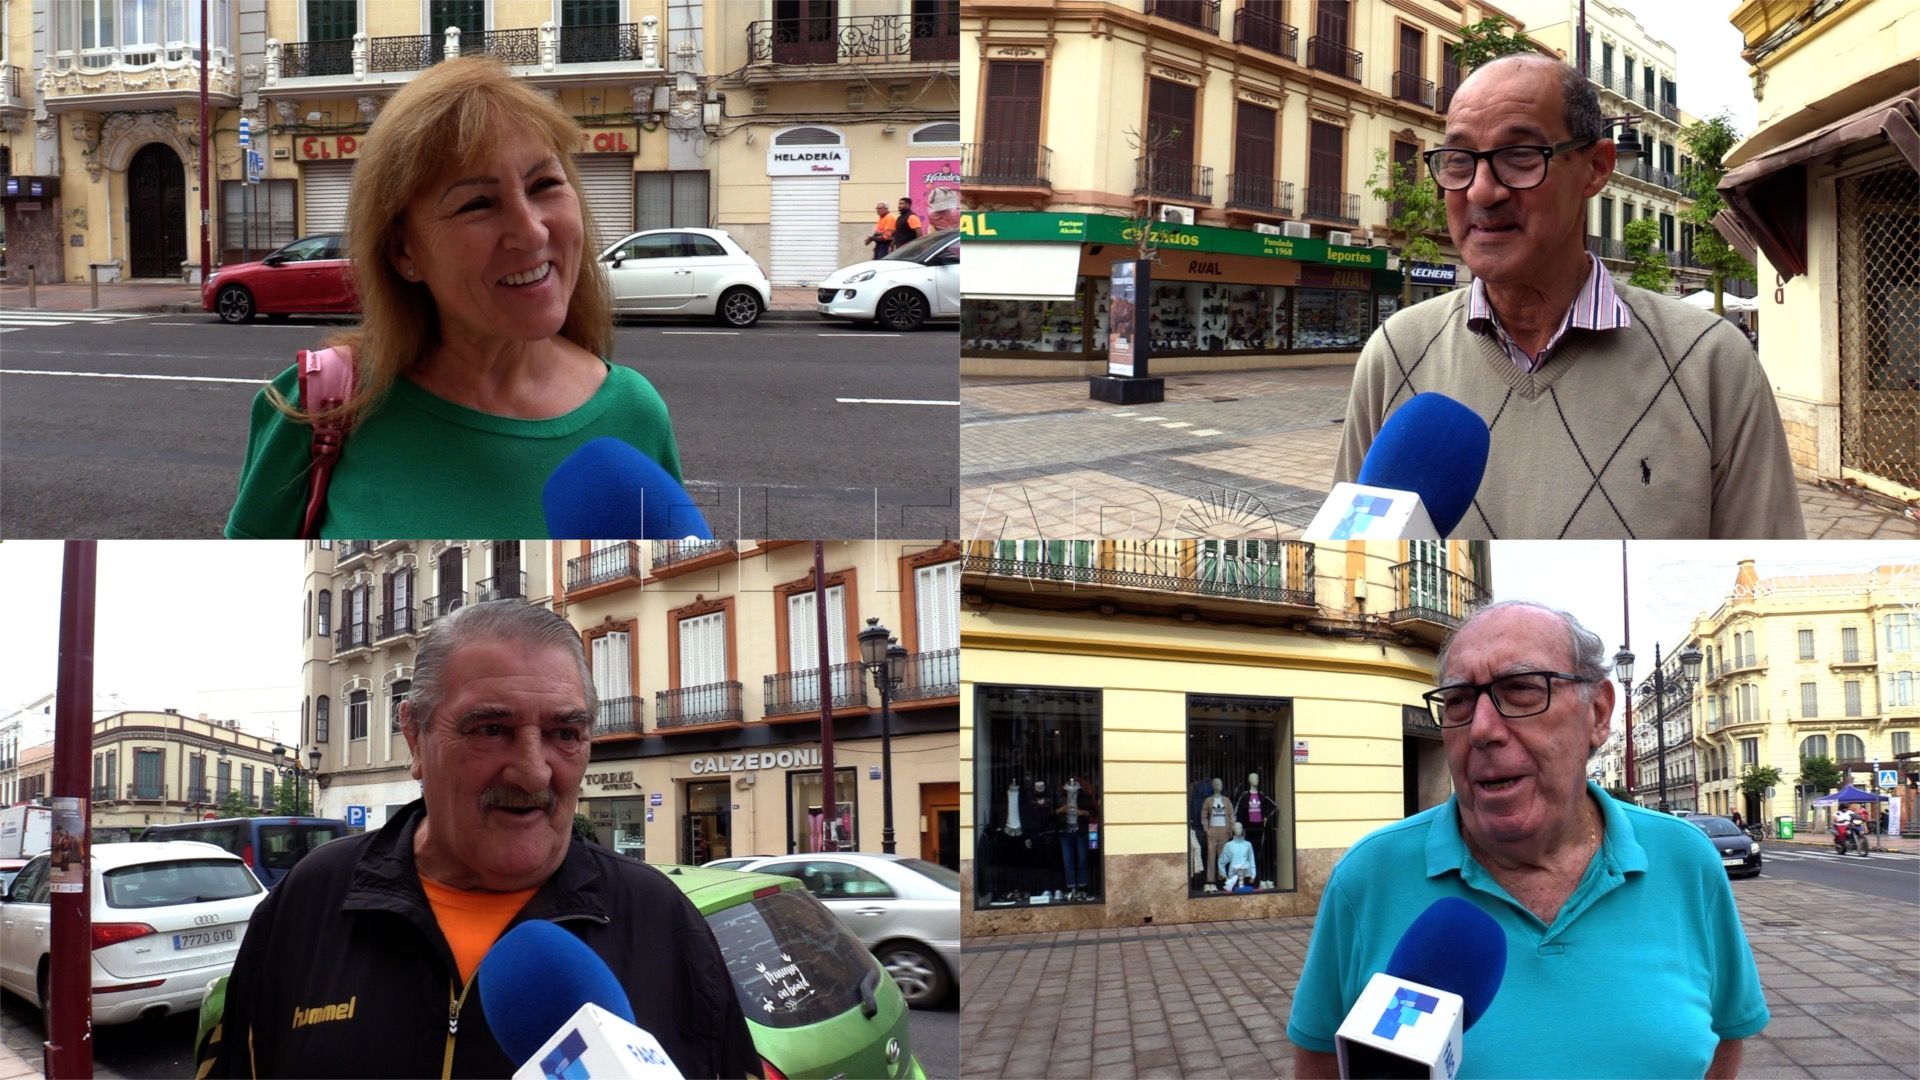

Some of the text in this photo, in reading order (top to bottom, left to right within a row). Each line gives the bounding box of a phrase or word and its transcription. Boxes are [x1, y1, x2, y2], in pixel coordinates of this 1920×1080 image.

[774, 152, 841, 161] HELADERÍA
[1264, 237, 1293, 248] Fundada
[1275, 247, 1293, 256] 1968
[1188, 260, 1222, 275] RUAL
[1333, 270, 1369, 288] RUAL
[585, 771, 633, 785] TORRES
[351, 808, 362, 824] P
[182, 929, 233, 947] 7770 GYD
[292, 996, 356, 1029] hummel
